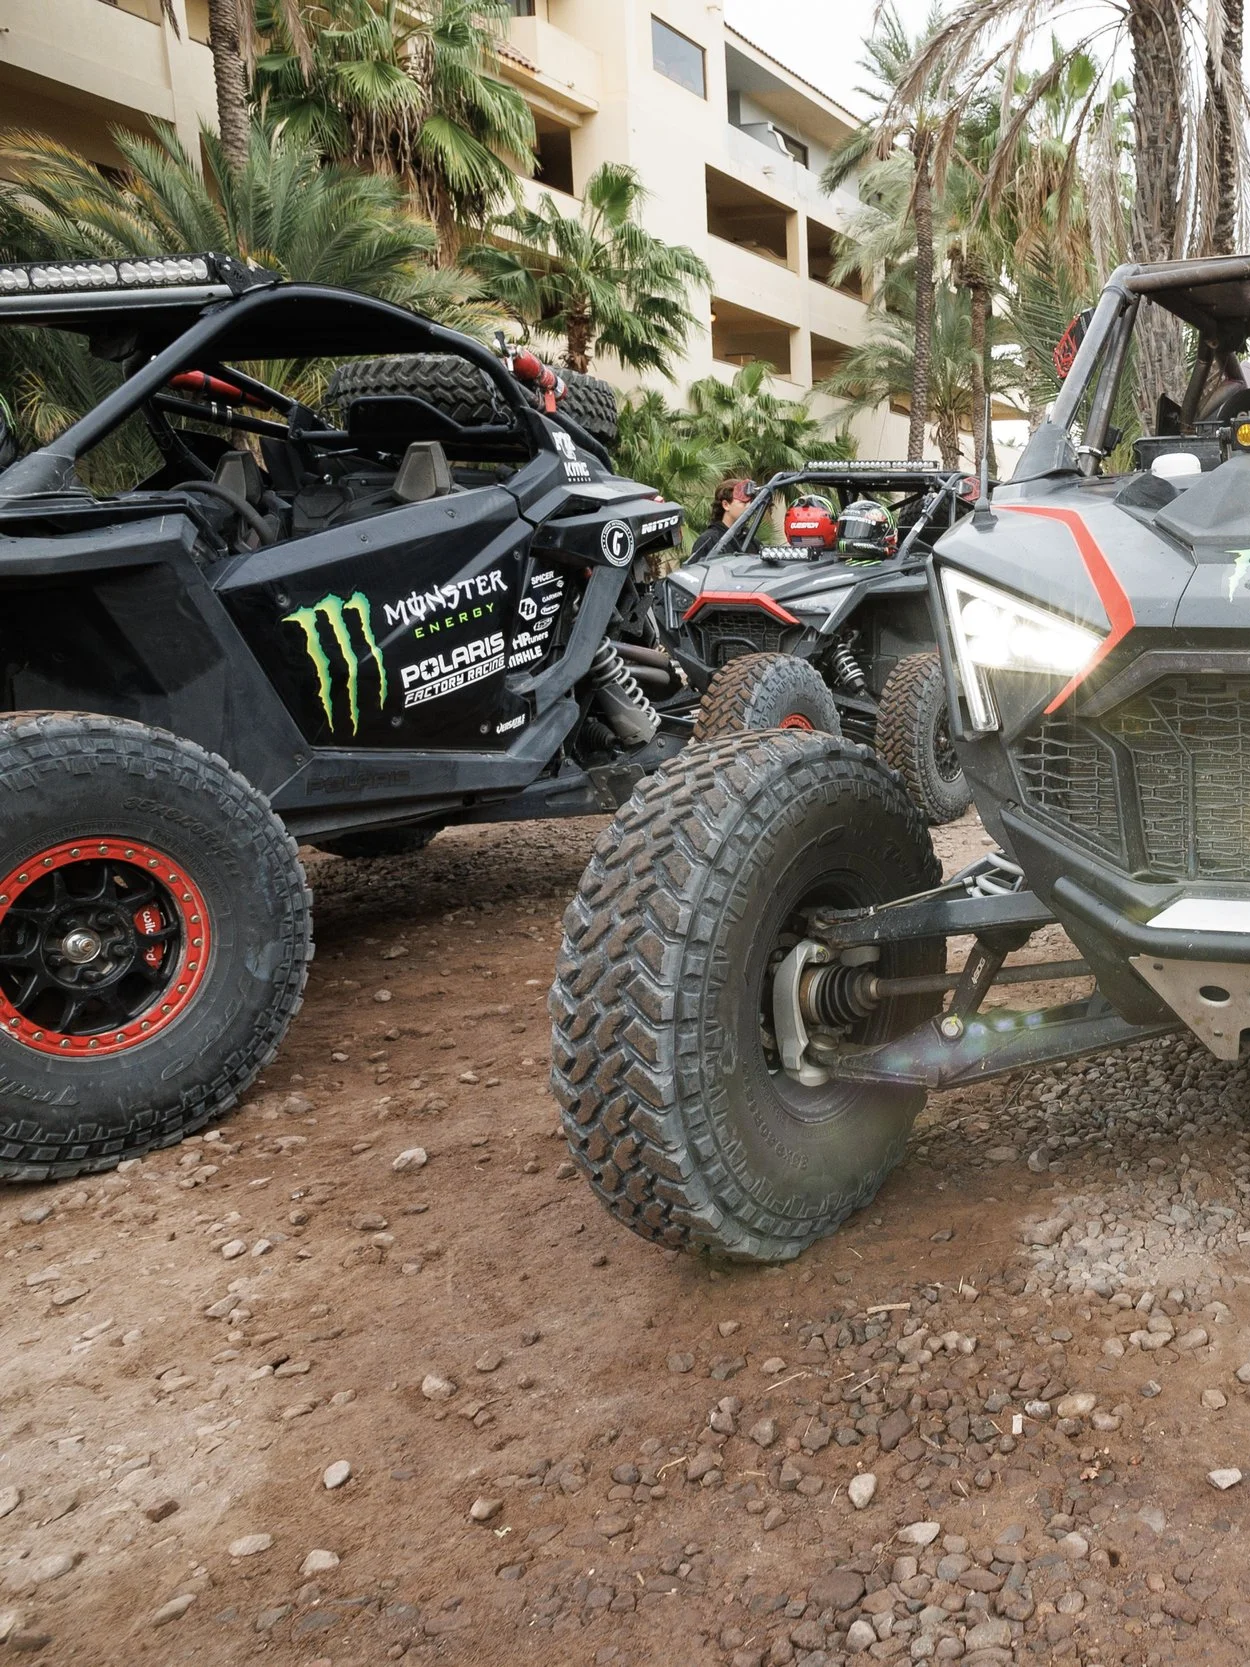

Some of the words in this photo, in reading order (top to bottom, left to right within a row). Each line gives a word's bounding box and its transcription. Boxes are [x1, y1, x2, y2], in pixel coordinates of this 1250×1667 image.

[564, 462, 590, 476] KMC
[641, 515, 679, 535] NITTO
[531, 570, 555, 586] SPICER
[541, 591, 563, 603] GARMIN
[414, 602, 495, 639] ENERGY
[400, 631, 506, 689] POLARIS
[508, 645, 543, 668] MAHLE
[404, 673, 465, 705] FACTORY
[467, 656, 506, 680] RACING
